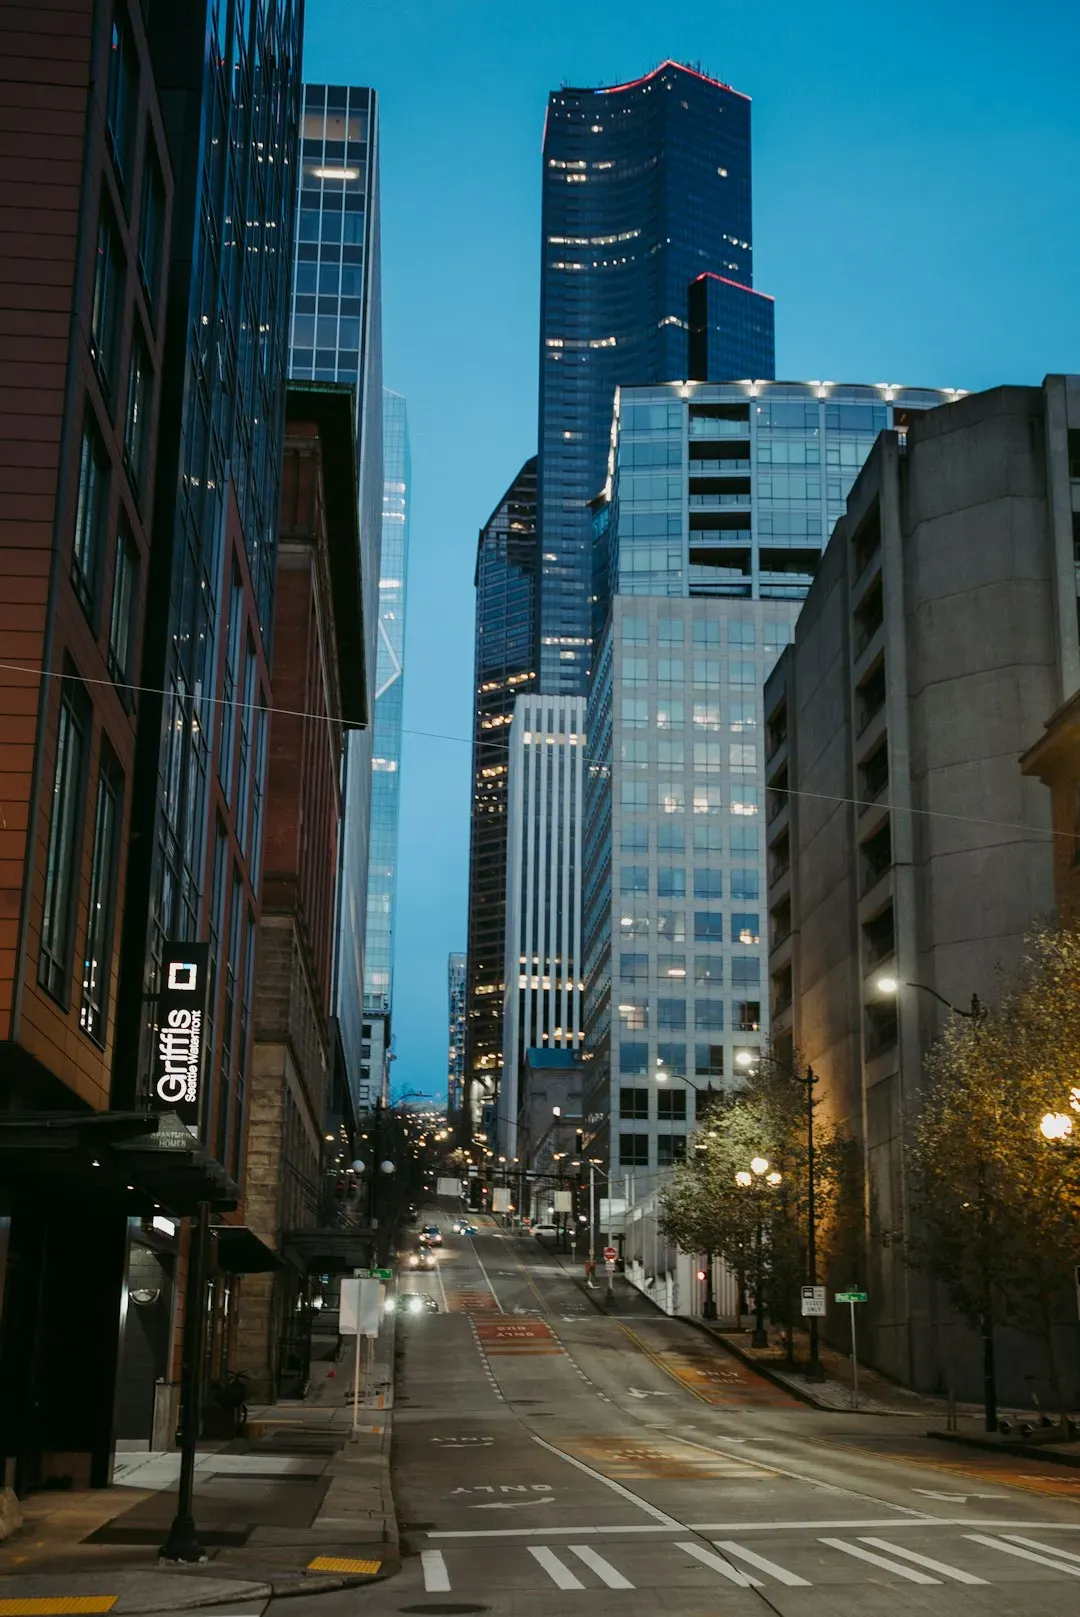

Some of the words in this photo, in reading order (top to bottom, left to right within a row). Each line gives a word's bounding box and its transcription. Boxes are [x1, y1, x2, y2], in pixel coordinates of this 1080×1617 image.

[156, 1008, 192, 1103] Griffis
[187, 1009, 202, 1065] Waterfront
[185, 1065, 198, 1103] Seattle
[450, 1484, 554, 1494] ONLY
